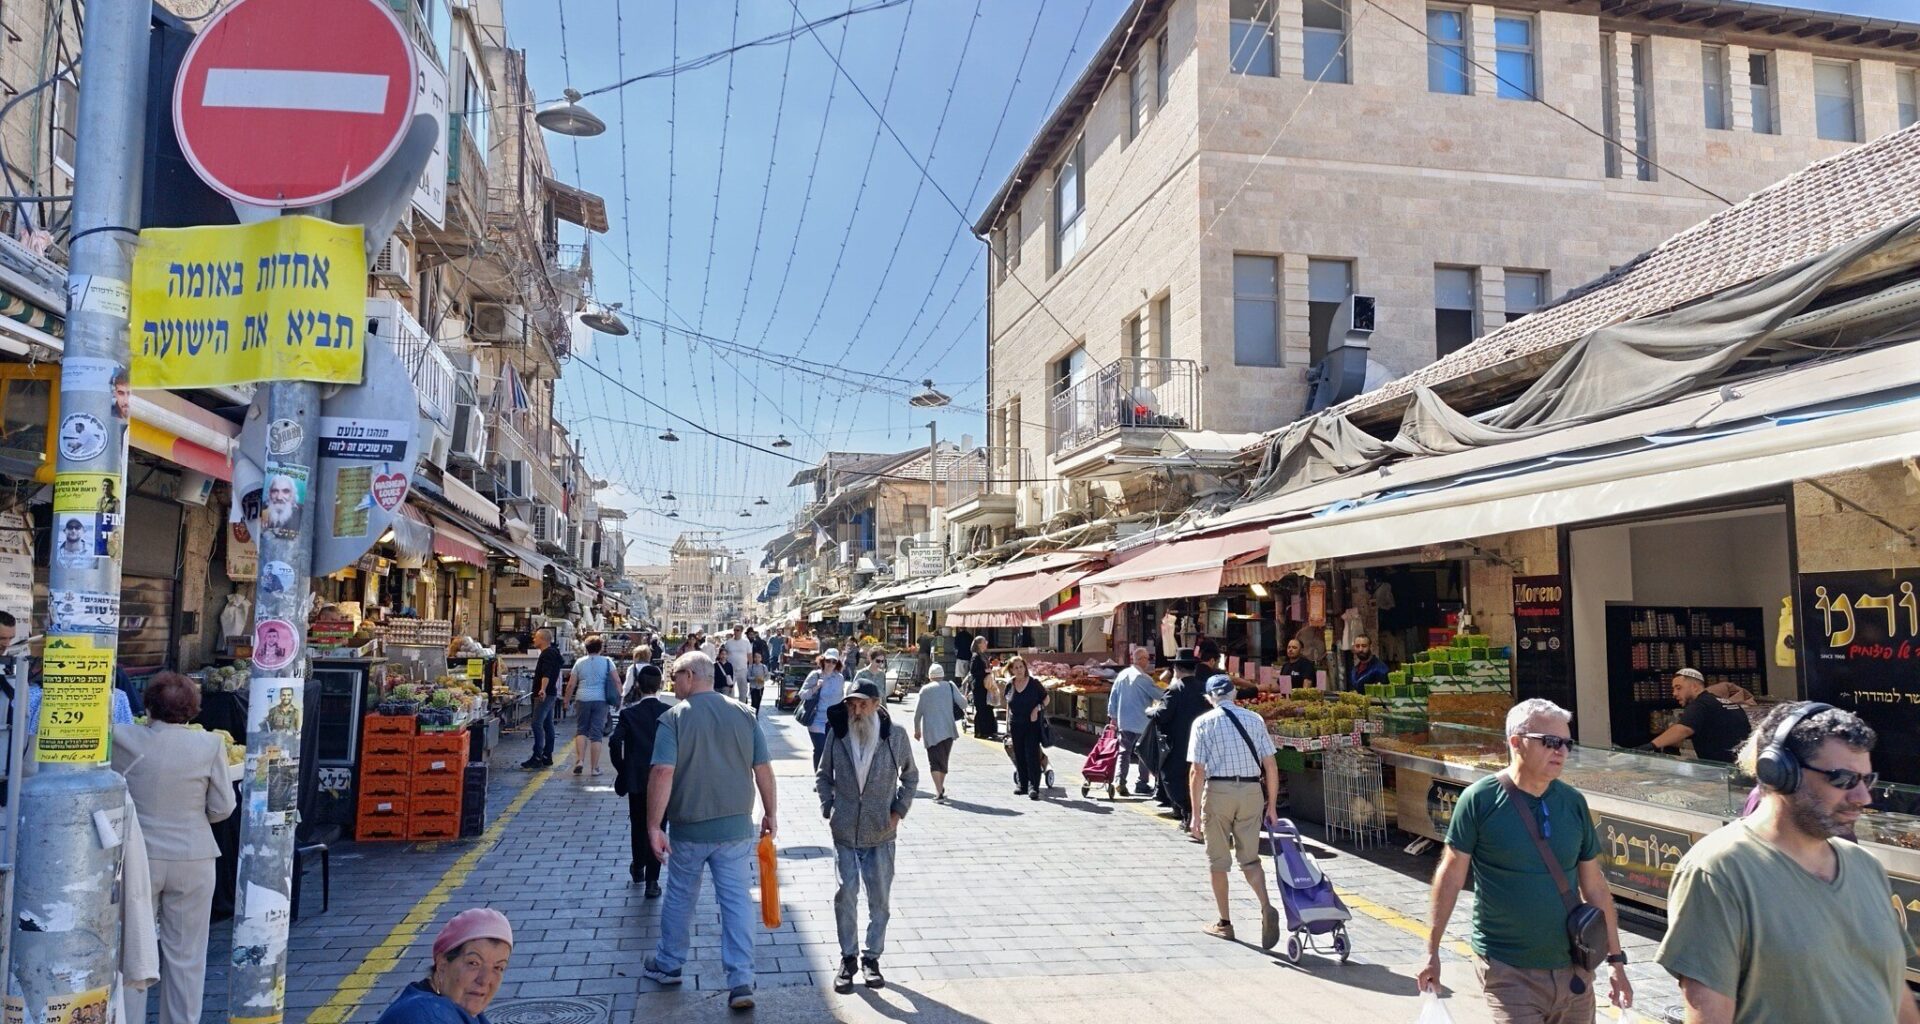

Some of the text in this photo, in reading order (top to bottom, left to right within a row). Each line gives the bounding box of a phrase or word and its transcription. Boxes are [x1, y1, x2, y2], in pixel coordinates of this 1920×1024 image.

[168, 252, 330, 298] אחדות באומה
[143, 308, 354, 360] תביא את הישועה
[336, 422, 389, 438] תנהגו בנועם
[327, 439, 394, 454] היו טובים זה לזה!
[374, 479, 406, 490] HASHEM
[378, 489, 401, 498] LOVES
[381, 496, 398, 506] YOU
[1515, 584, 1562, 603] Moreno
[84, 605, 108, 615] טוב
[1815, 581, 1918, 648] ורנו
[1854, 687, 1920, 705] שר למהדרין
[50, 711, 83, 724] 5.29
[1607, 825, 1683, 872] מורנו
